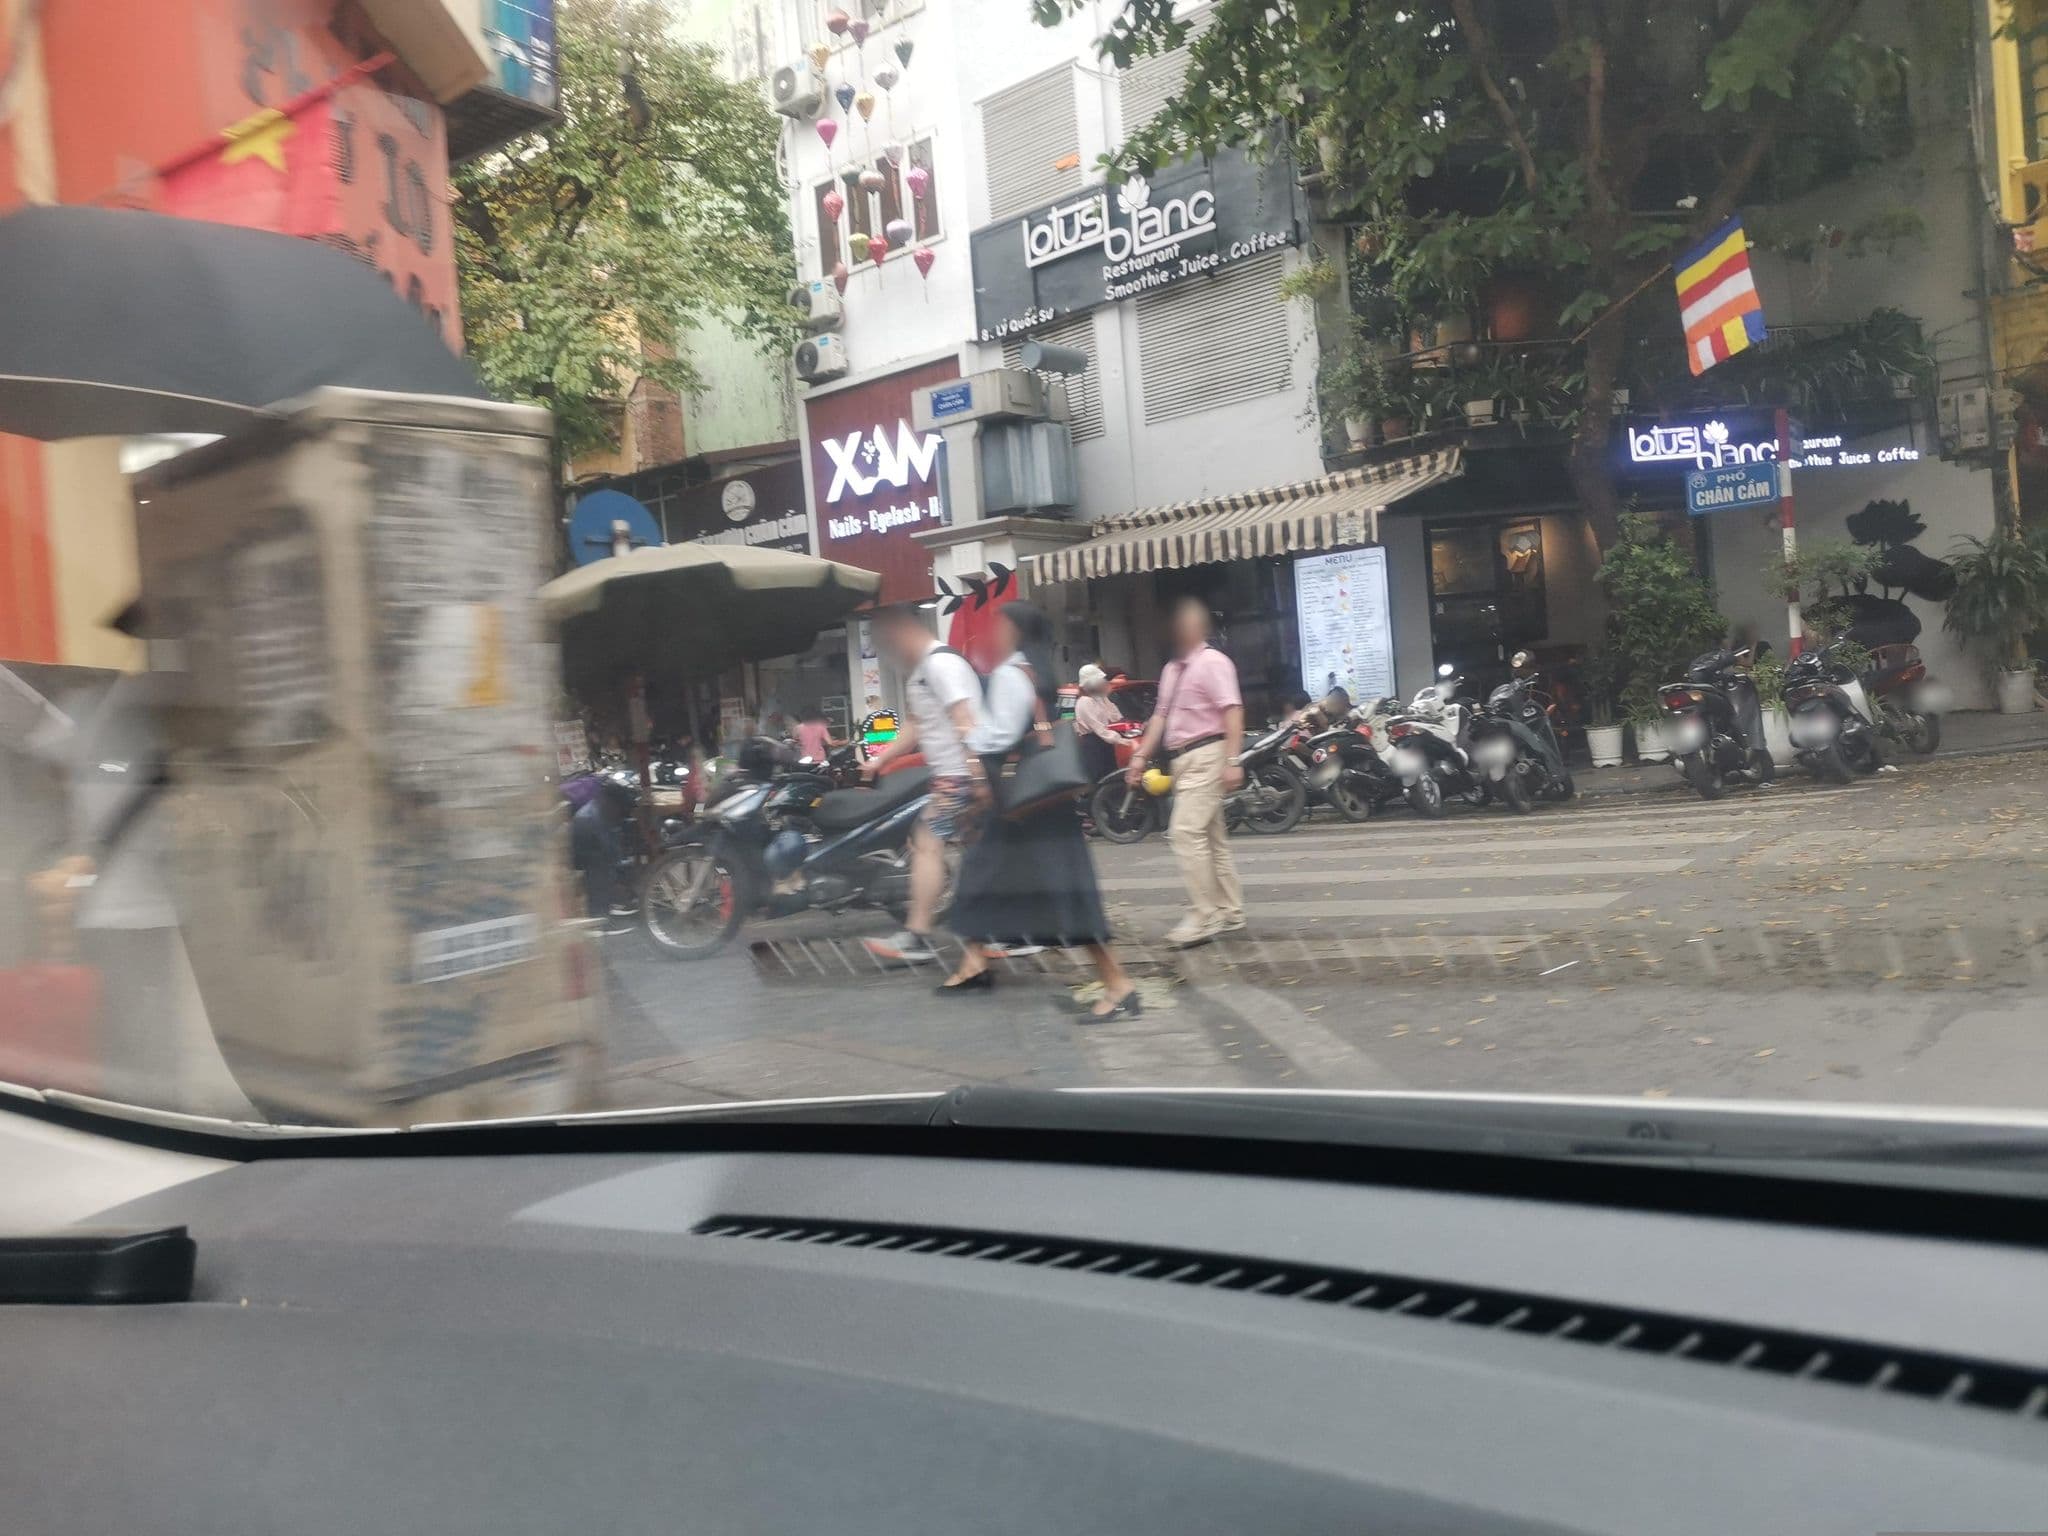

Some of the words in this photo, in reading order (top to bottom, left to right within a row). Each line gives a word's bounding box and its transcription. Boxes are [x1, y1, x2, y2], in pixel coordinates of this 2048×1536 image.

[1229, 231, 1287, 260] Coffee
[1102, 243, 1181, 281] Restaurant
[1802, 435, 1842, 449] aurant
[1838, 451, 1872, 465] Juice
[1878, 446, 1919, 463] Coffee
[1716, 468, 1746, 484] PHỐ
[1696, 485, 1735, 506] CHÂN
[1738, 479, 1770, 500] CẦM
[828, 514, 863, 539] Nails
[868, 501, 921, 534] Eyelash
